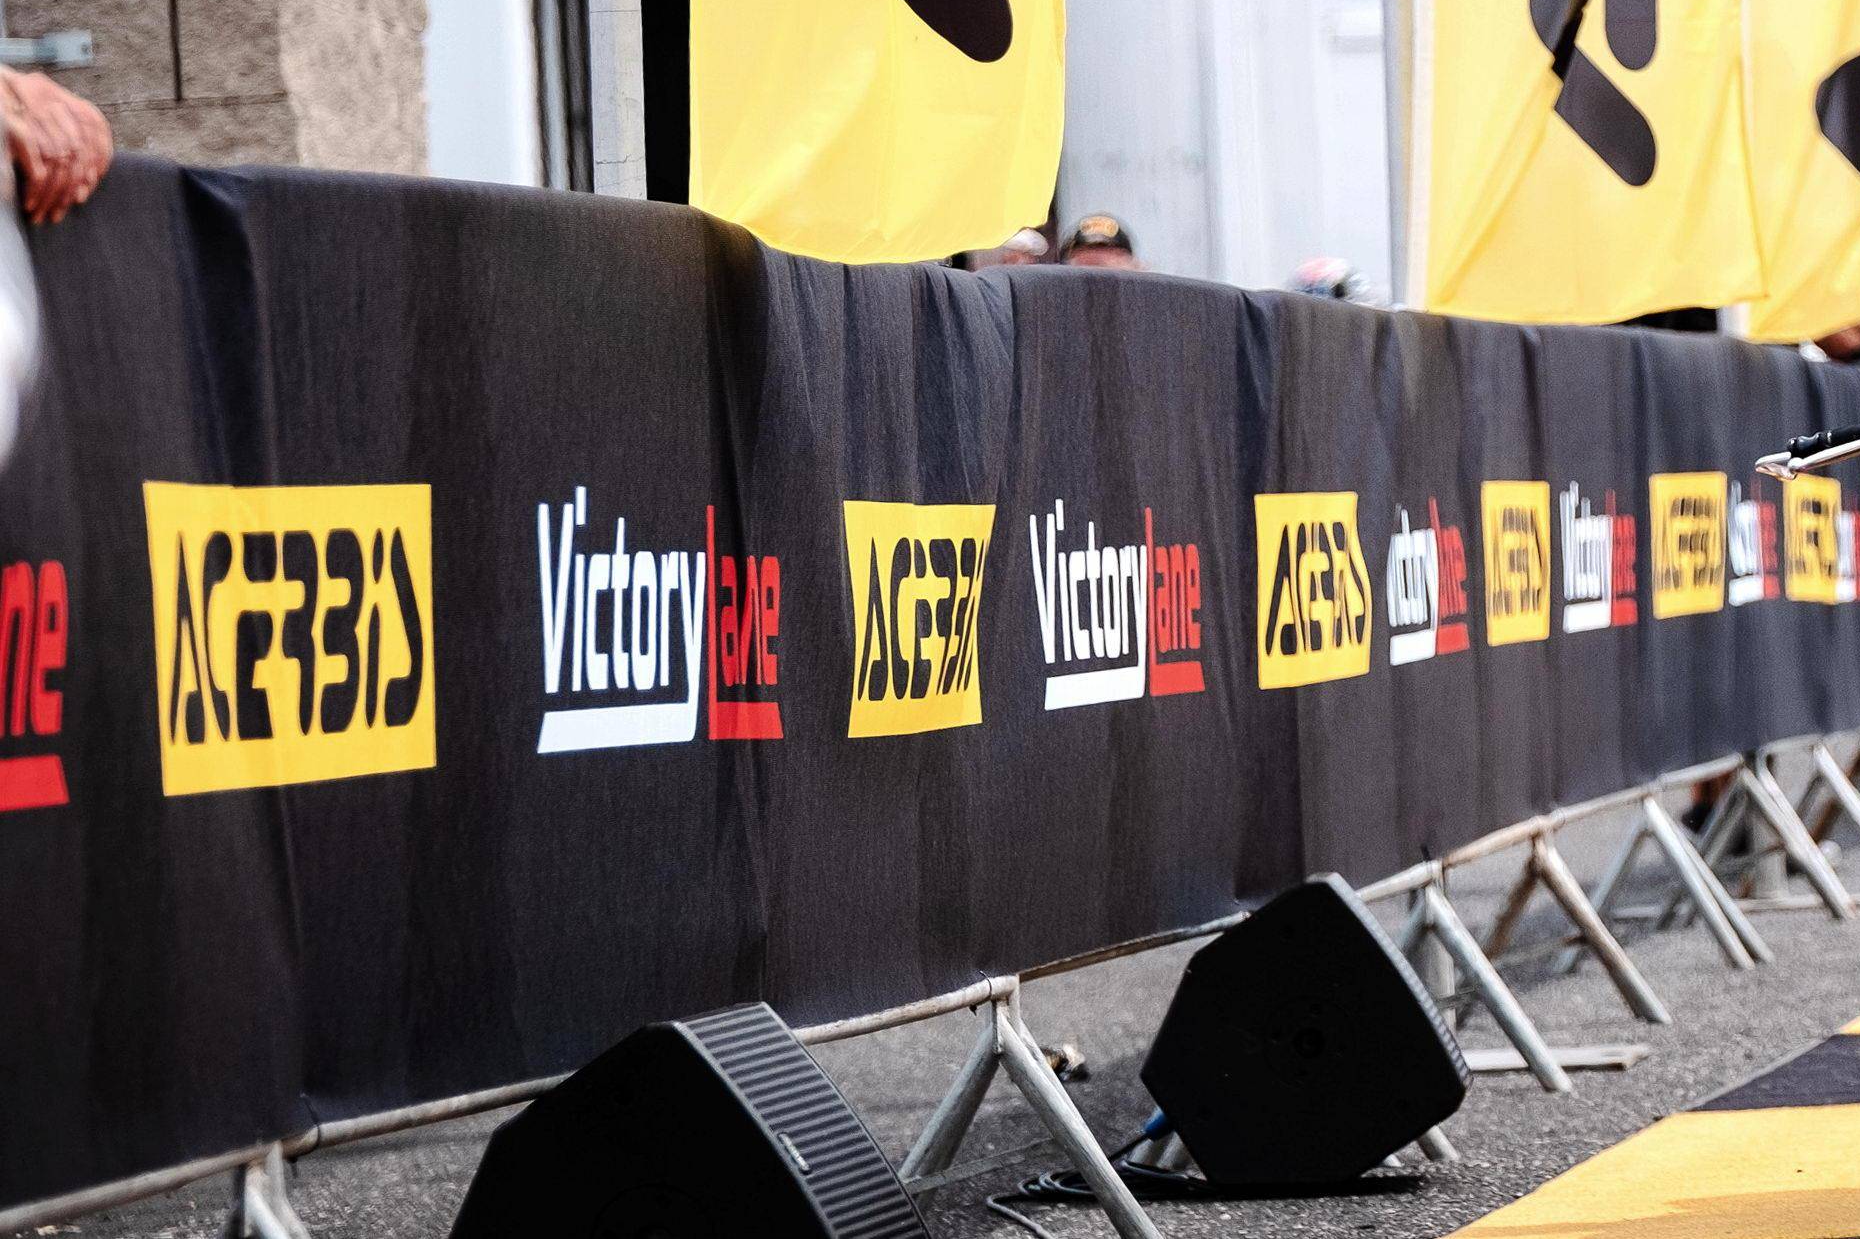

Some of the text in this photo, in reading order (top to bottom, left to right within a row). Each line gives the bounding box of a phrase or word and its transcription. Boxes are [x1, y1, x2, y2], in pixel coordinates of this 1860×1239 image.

[170, 526, 424, 746] ACERBIS
[537, 486, 706, 753] Victory
[1029, 498, 1147, 710] Victory
